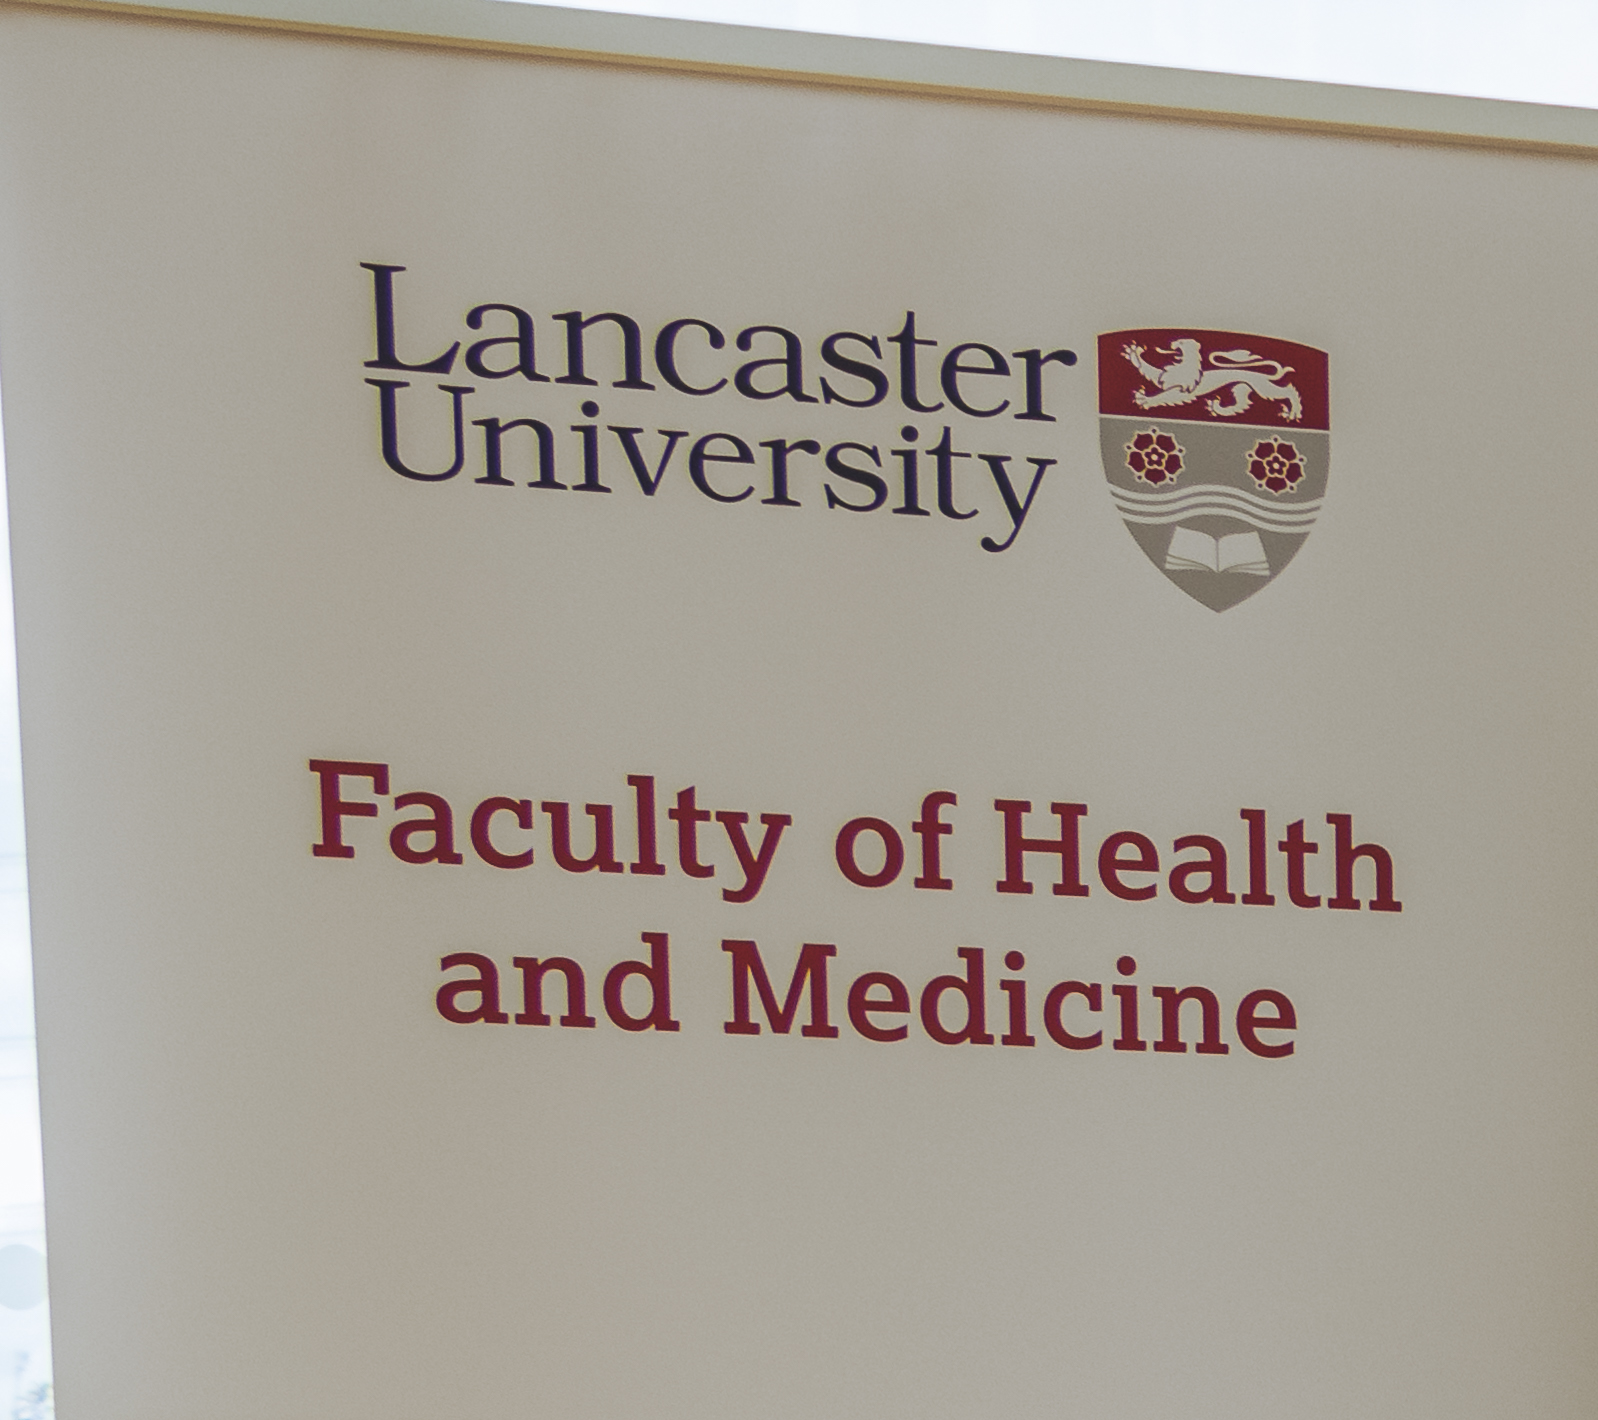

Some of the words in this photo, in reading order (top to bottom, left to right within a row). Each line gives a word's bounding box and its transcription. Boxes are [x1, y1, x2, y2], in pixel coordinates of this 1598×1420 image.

[359, 260, 1078, 423] Lancaster
[363, 376, 1059, 554] University
[308, 759, 792, 905] Faculty
[833, 791, 958, 896] of
[995, 796, 1404, 914] Health
[434, 931, 680, 1034] and
[720, 938, 1300, 1060] Medicine
